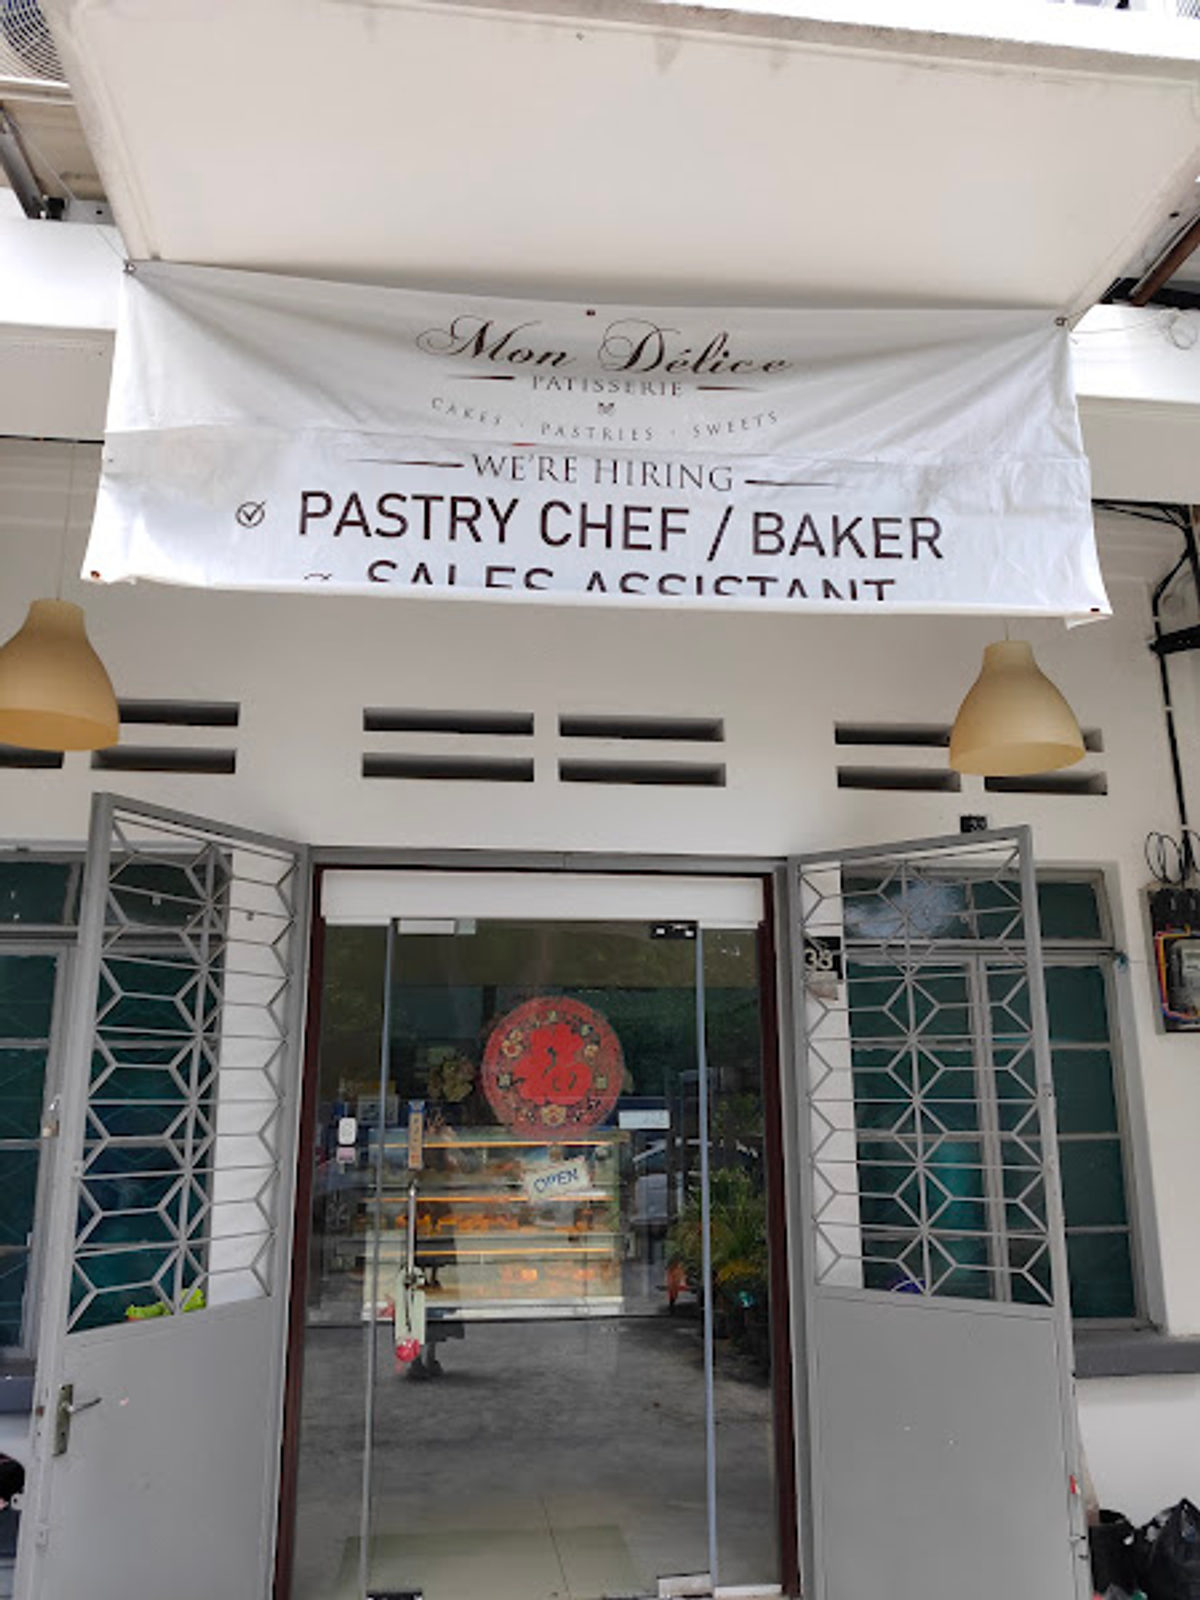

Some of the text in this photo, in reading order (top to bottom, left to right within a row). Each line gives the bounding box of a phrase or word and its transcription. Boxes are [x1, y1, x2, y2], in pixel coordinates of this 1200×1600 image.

[416, 316, 792, 375] Mon Délice
[533, 375, 682, 397] PATISSERIE
[431, 397, 778, 442] CAKES PASTRIES SWEETS
[472, 452, 733, 492] WE'RE HIRING
[300, 490, 944, 562] PASTRY CHEF / BAKER
[533, 1167, 579, 1193] OPEN
